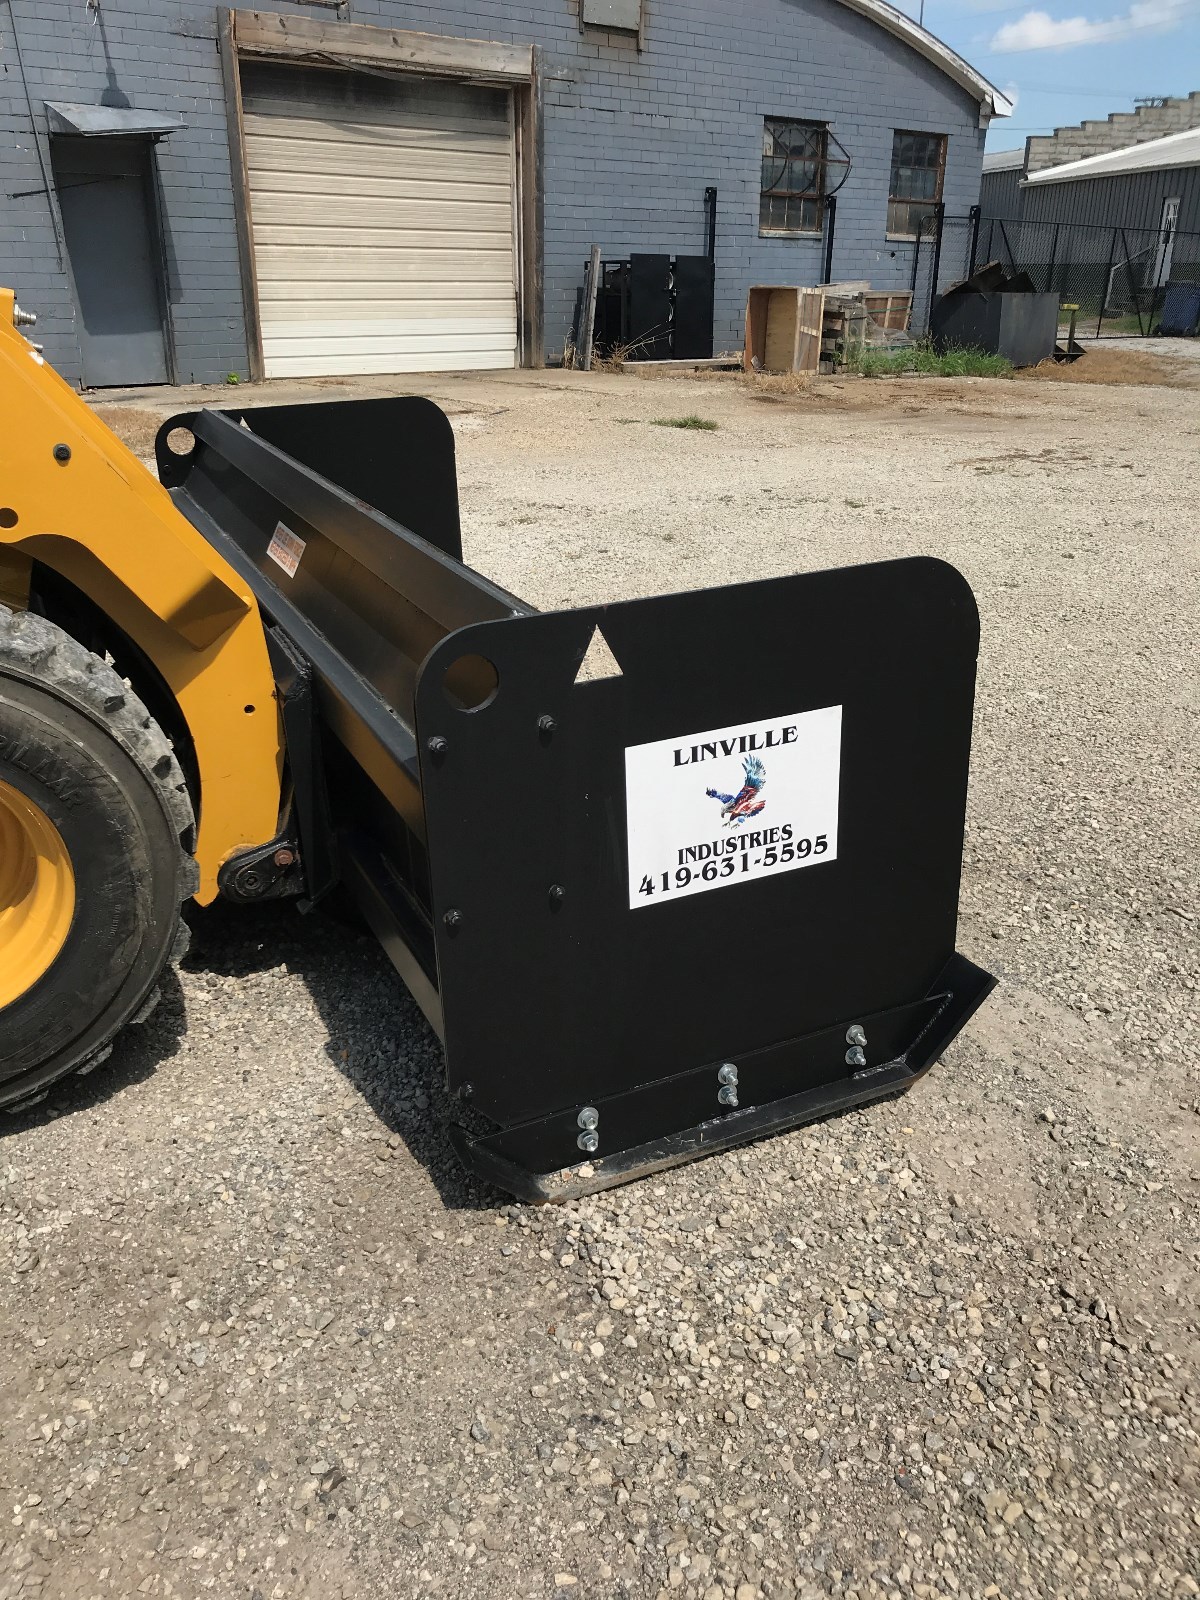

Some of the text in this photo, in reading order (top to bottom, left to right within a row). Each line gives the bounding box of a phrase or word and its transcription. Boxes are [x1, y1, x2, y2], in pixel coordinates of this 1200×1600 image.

[673, 725, 799, 767] LINVILLE
[638, 834, 828, 896] 419-631-5595
[677, 823, 793, 865] INDUSTRIES
